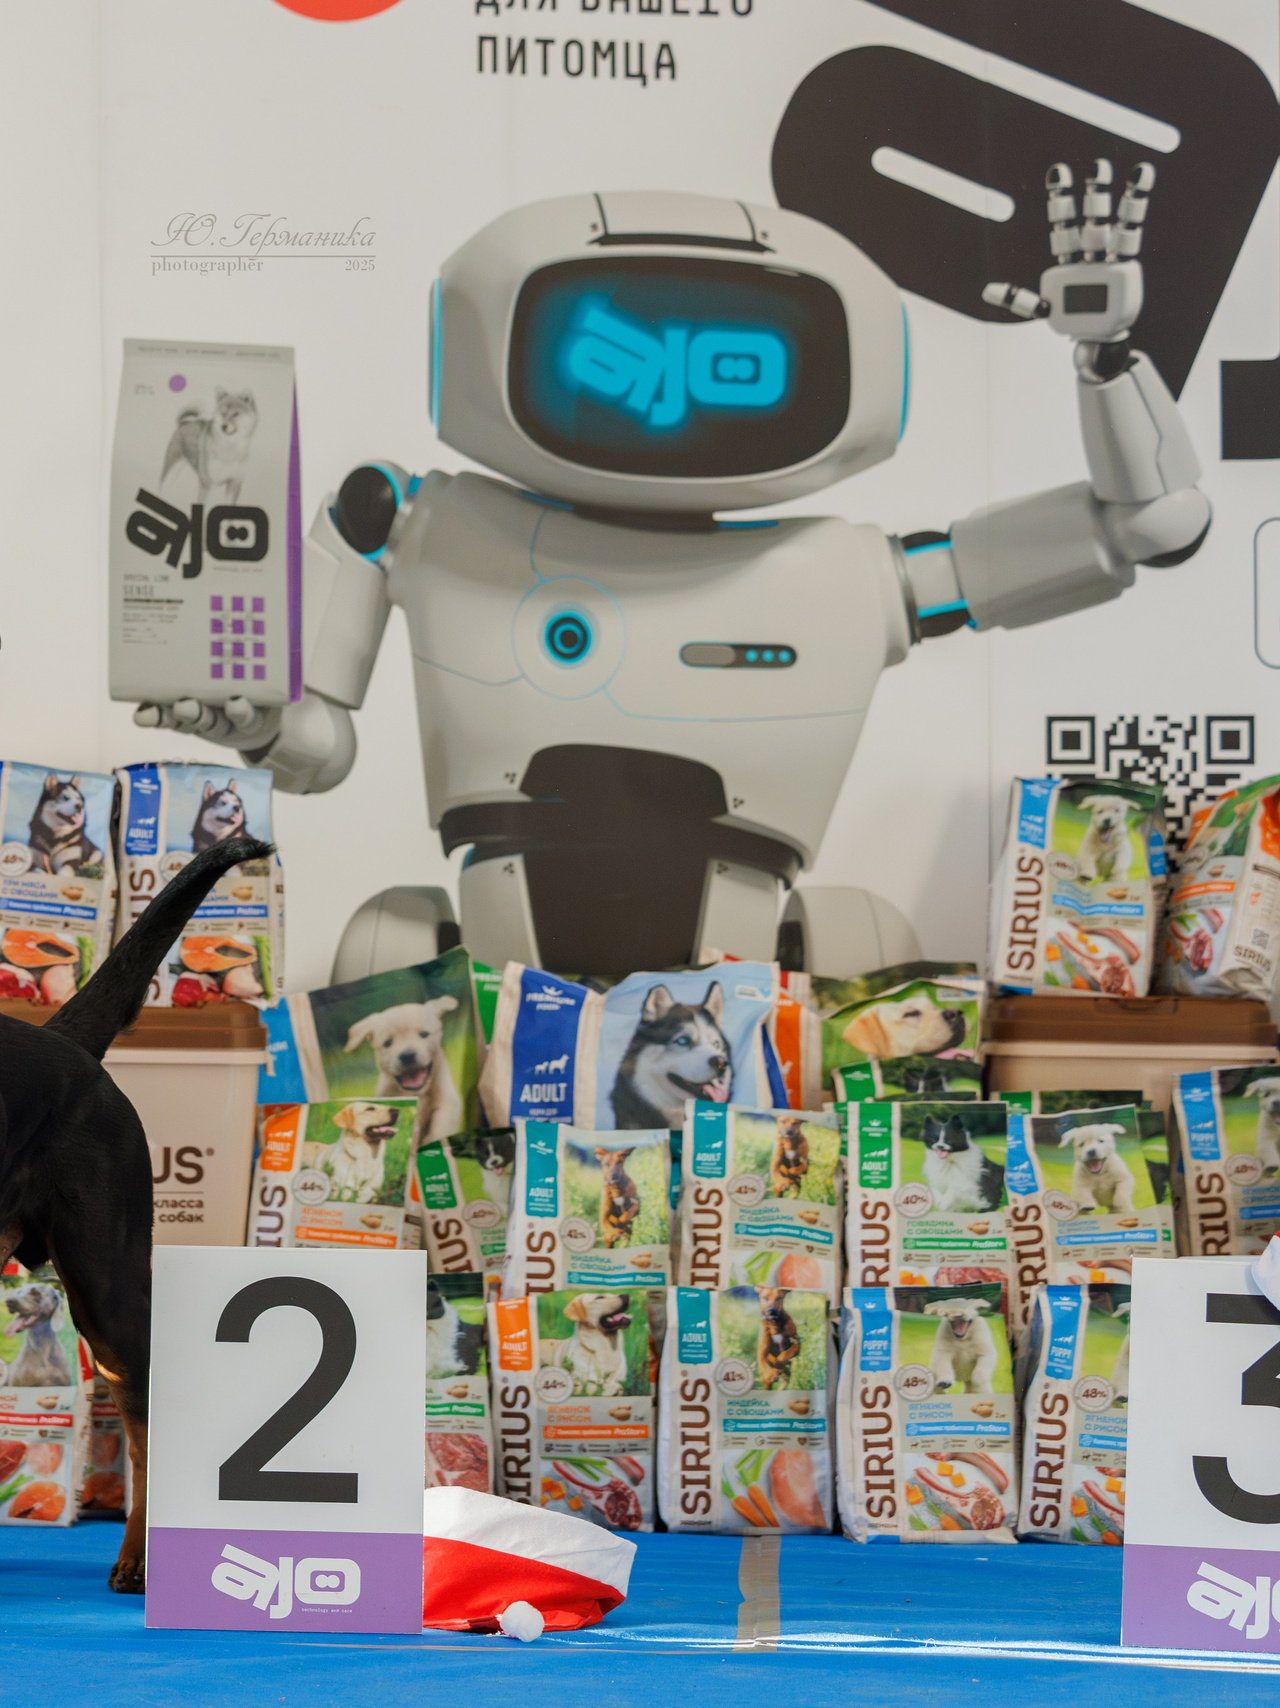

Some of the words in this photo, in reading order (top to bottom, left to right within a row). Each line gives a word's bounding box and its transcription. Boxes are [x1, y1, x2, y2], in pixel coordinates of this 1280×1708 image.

[478, 35, 677, 88] ПИТОМЦА
[1007, 856, 1043, 971] SIRIUS
[519, 1083, 568, 1103] ADULT
[862, 1161, 888, 1171] ADULT
[158, 1211, 204, 1223] собак
[690, 1188, 724, 1290] IRIUS
[682, 1333, 707, 1343] ADULT
[502, 1341, 528, 1352] ADULT
[1051, 1346, 1072, 1359] PUPPY
[903, 1376, 928, 1388] 48%
[215, 1276, 358, 1504] 2
[1082, 1387, 1107, 1398] 48%
[908, 1403, 952, 1411] ЯГНЕНОК
[918, 1412, 953, 1420] РИСОМ
[680, 1378, 711, 1515] SIRIUS
[860, 1385, 897, 1518] SIRIUS
[1029, 1392, 1069, 1528] SIRIUS
